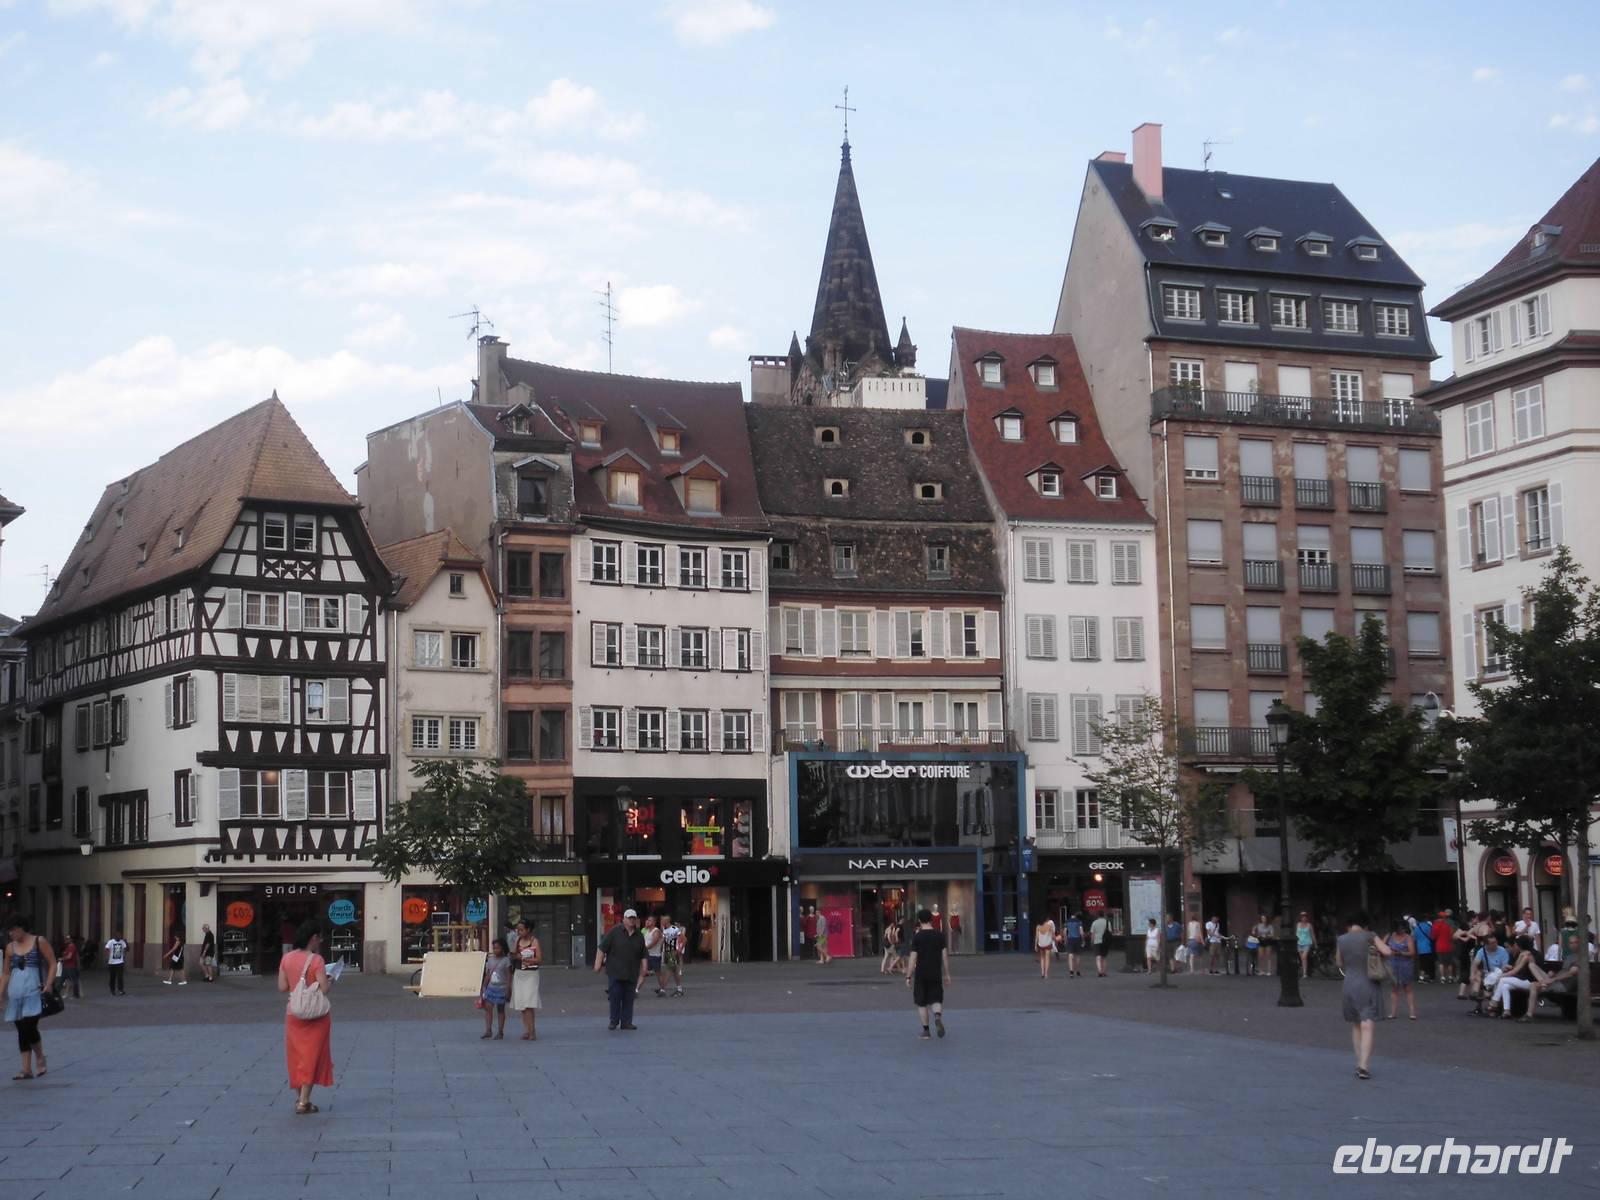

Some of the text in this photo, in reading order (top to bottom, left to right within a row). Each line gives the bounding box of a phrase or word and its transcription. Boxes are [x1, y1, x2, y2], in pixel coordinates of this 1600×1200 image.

[846, 760, 970, 778] weber COIFFURE
[848, 859, 929, 869] NAF NAF
[1088, 862, 1124, 870] GEOX
[549, 880, 561, 888] DE
